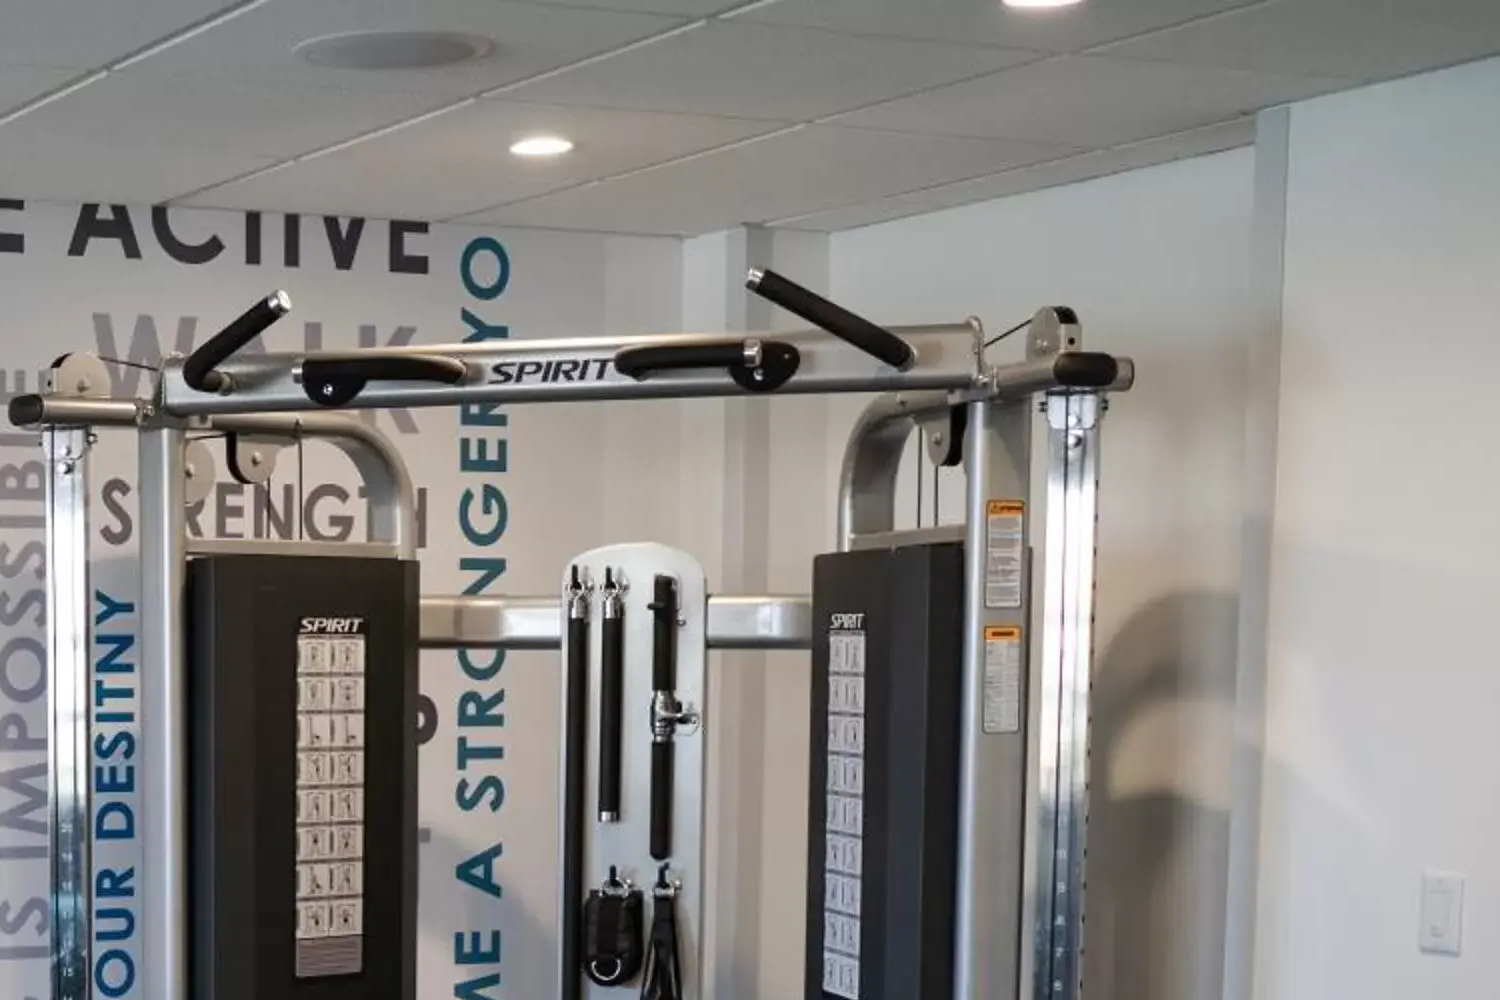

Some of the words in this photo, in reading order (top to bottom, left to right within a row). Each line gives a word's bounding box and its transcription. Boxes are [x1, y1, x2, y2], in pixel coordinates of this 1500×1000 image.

[488, 358, 616, 385] SPIRIT
[100, 478, 428, 548] SRENG
[300, 617, 364, 633] SPIRIT
[94, 589, 136, 840] DESITNY
[455, 843, 502, 898] A
